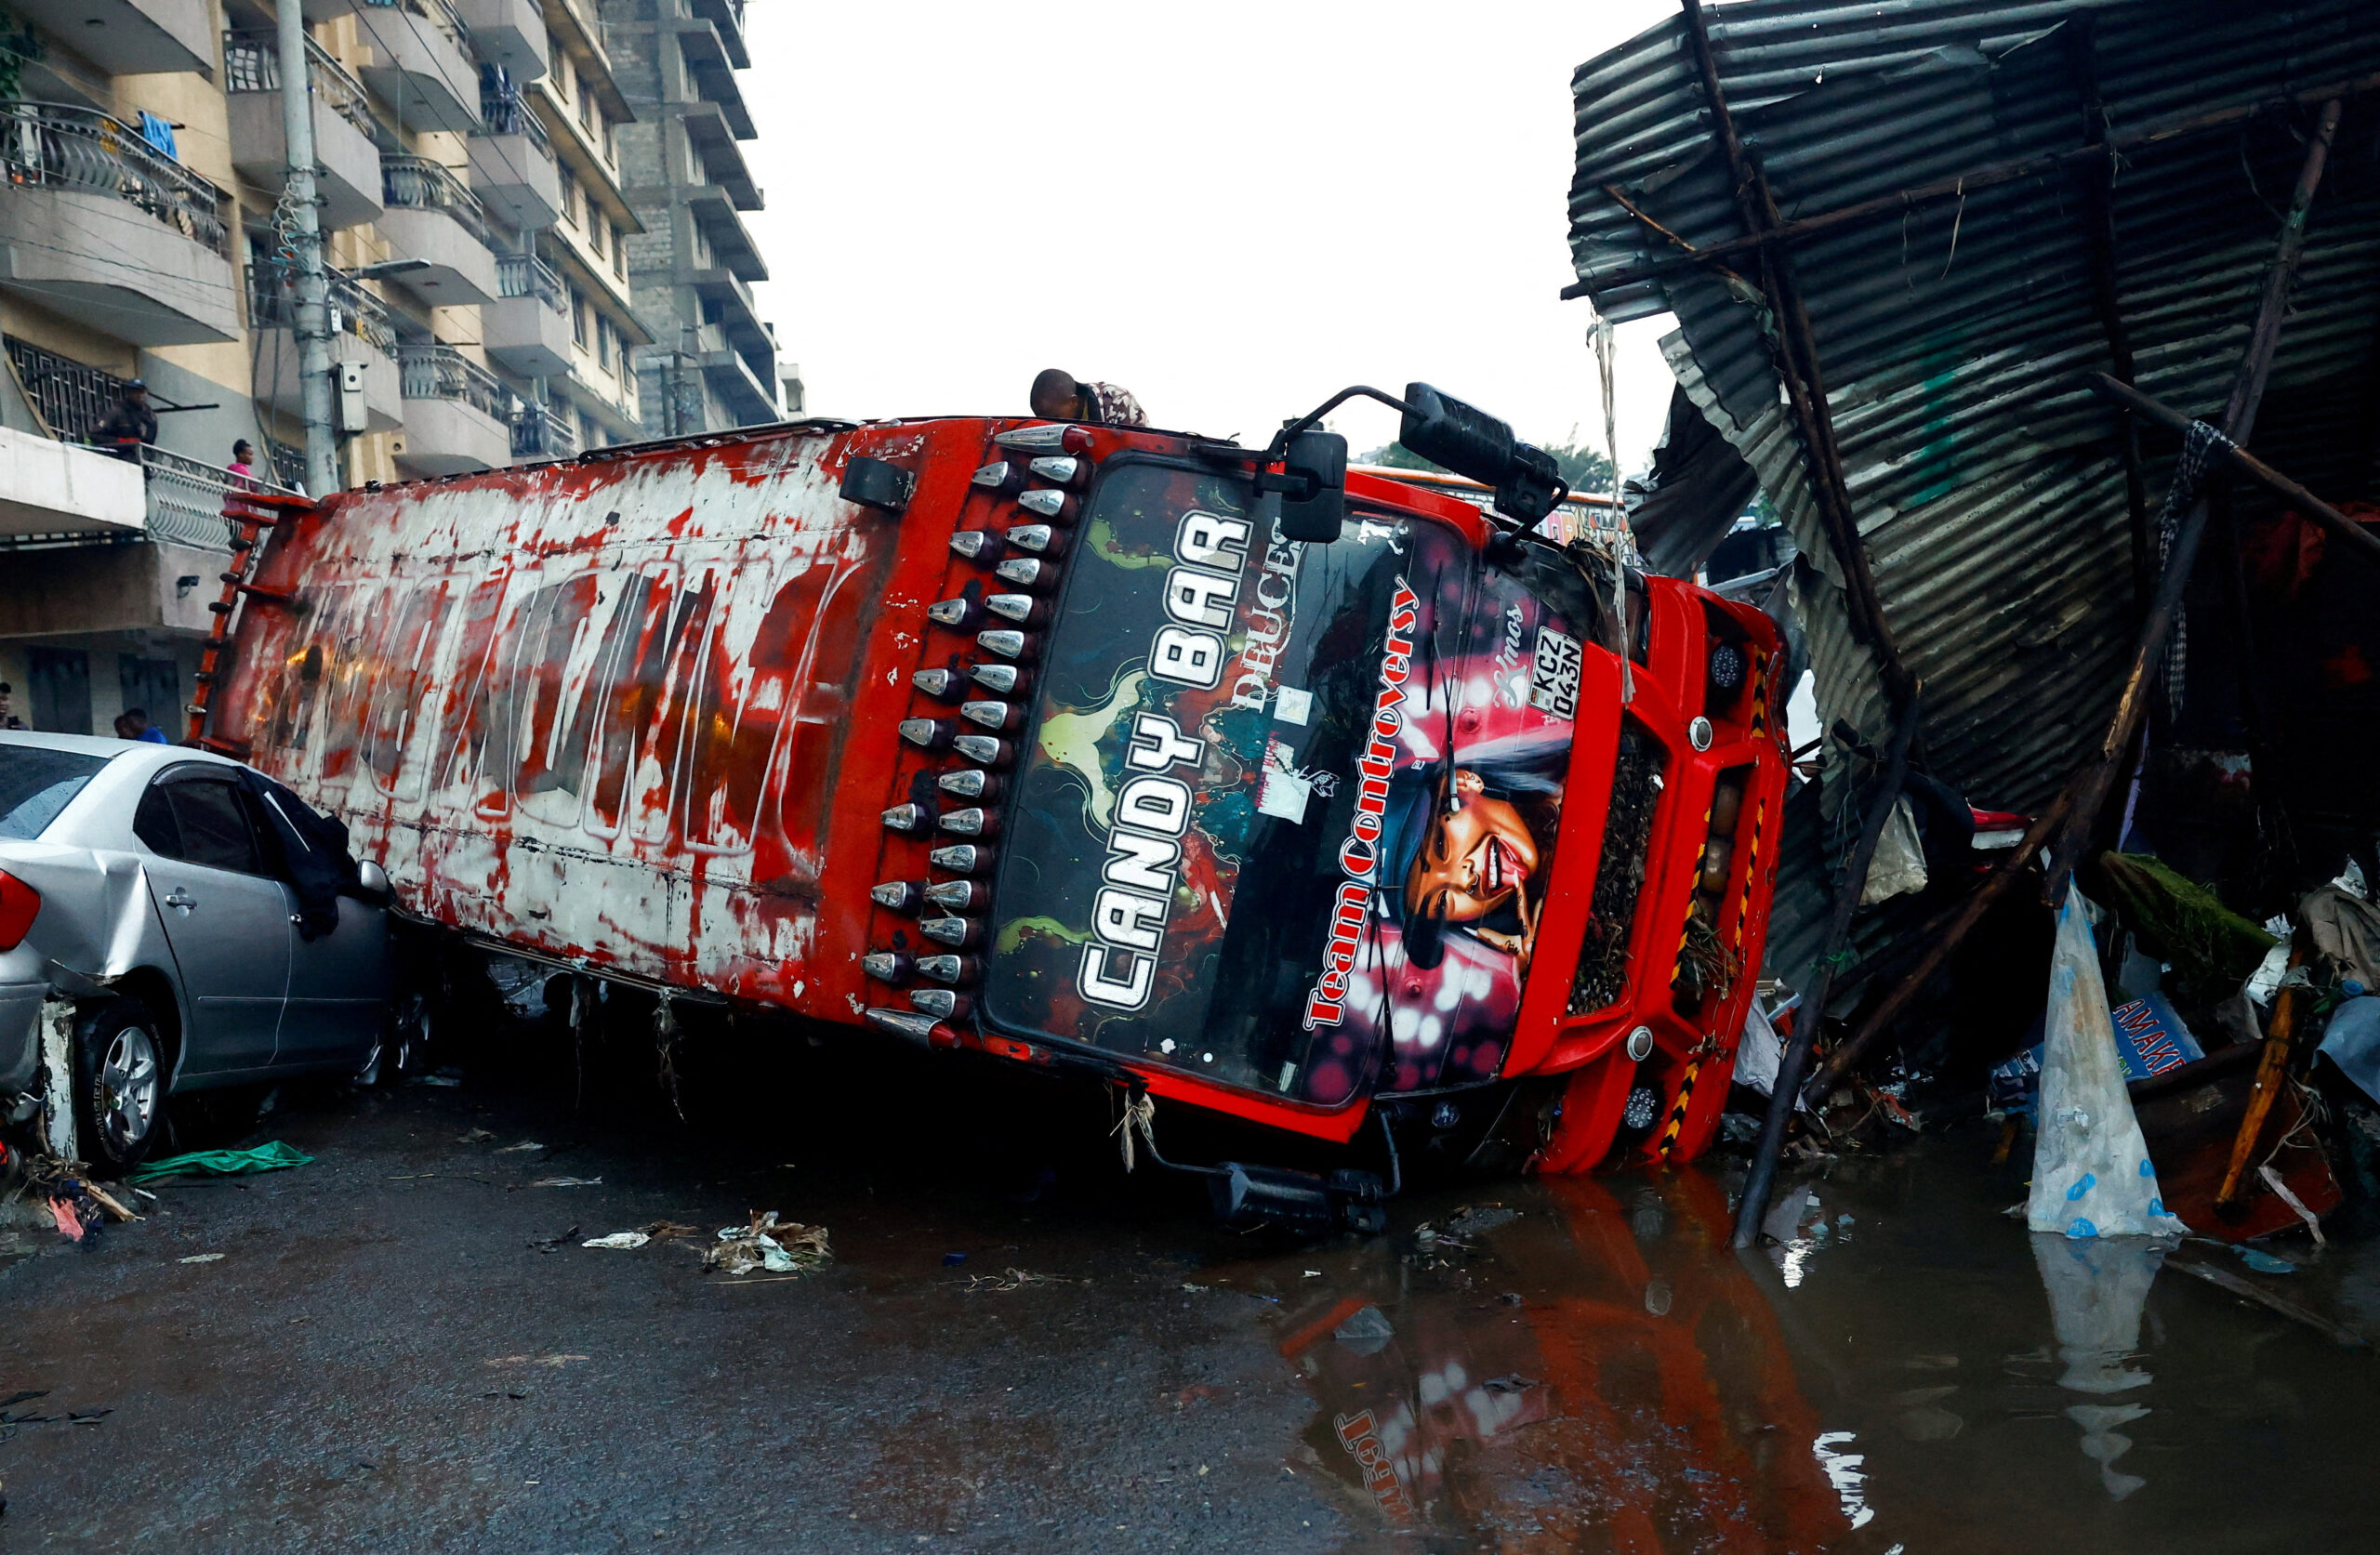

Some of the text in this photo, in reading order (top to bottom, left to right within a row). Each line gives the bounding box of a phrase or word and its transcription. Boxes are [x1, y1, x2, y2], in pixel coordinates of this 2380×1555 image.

[1077, 507, 1253, 1011] CANDY BAR
[1534, 635, 1562, 692] KCZ
[1554, 644, 1580, 715] 043N
[1302, 573, 1420, 1030] Team Controversy
